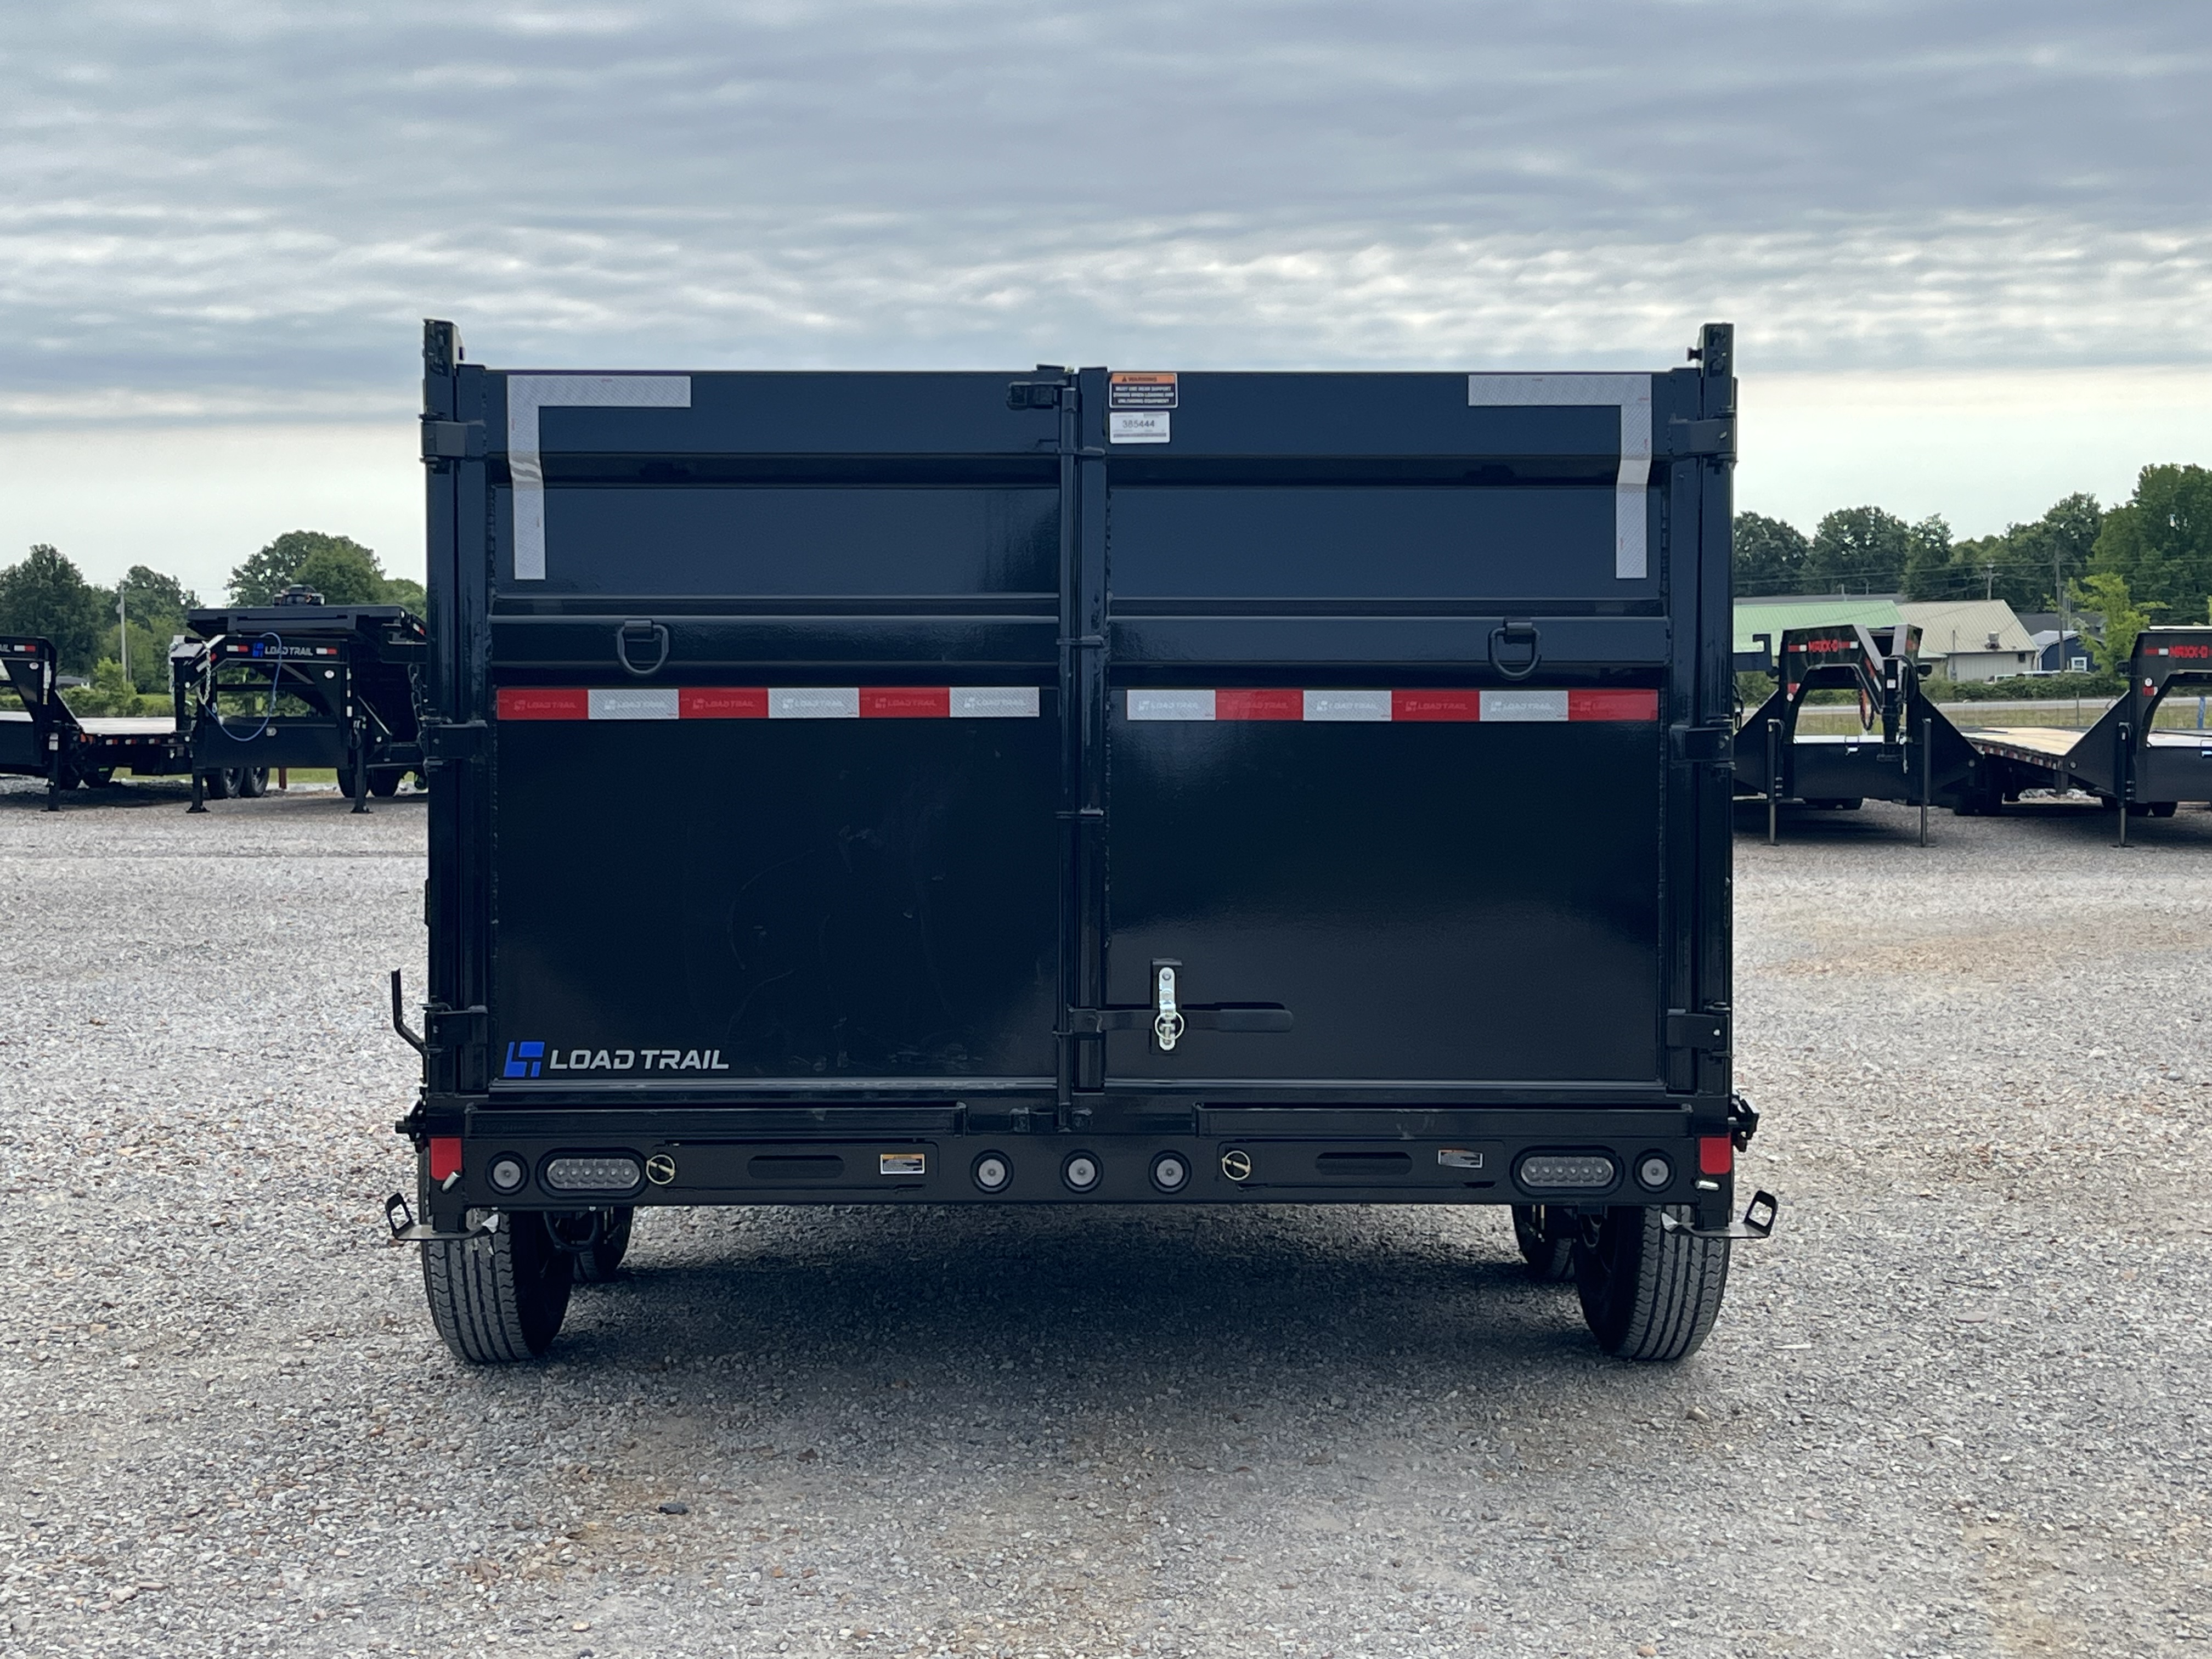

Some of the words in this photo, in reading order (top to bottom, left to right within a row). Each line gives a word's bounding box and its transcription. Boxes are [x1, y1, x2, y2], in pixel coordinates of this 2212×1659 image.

[1122, 420, 1155, 428] 385444
[264, 646, 289, 655] LOAD
[290, 647, 313, 656] TRAIL
[550, 1049, 635, 1069] LOAD
[640, 1049, 729, 1069] TRAIL
